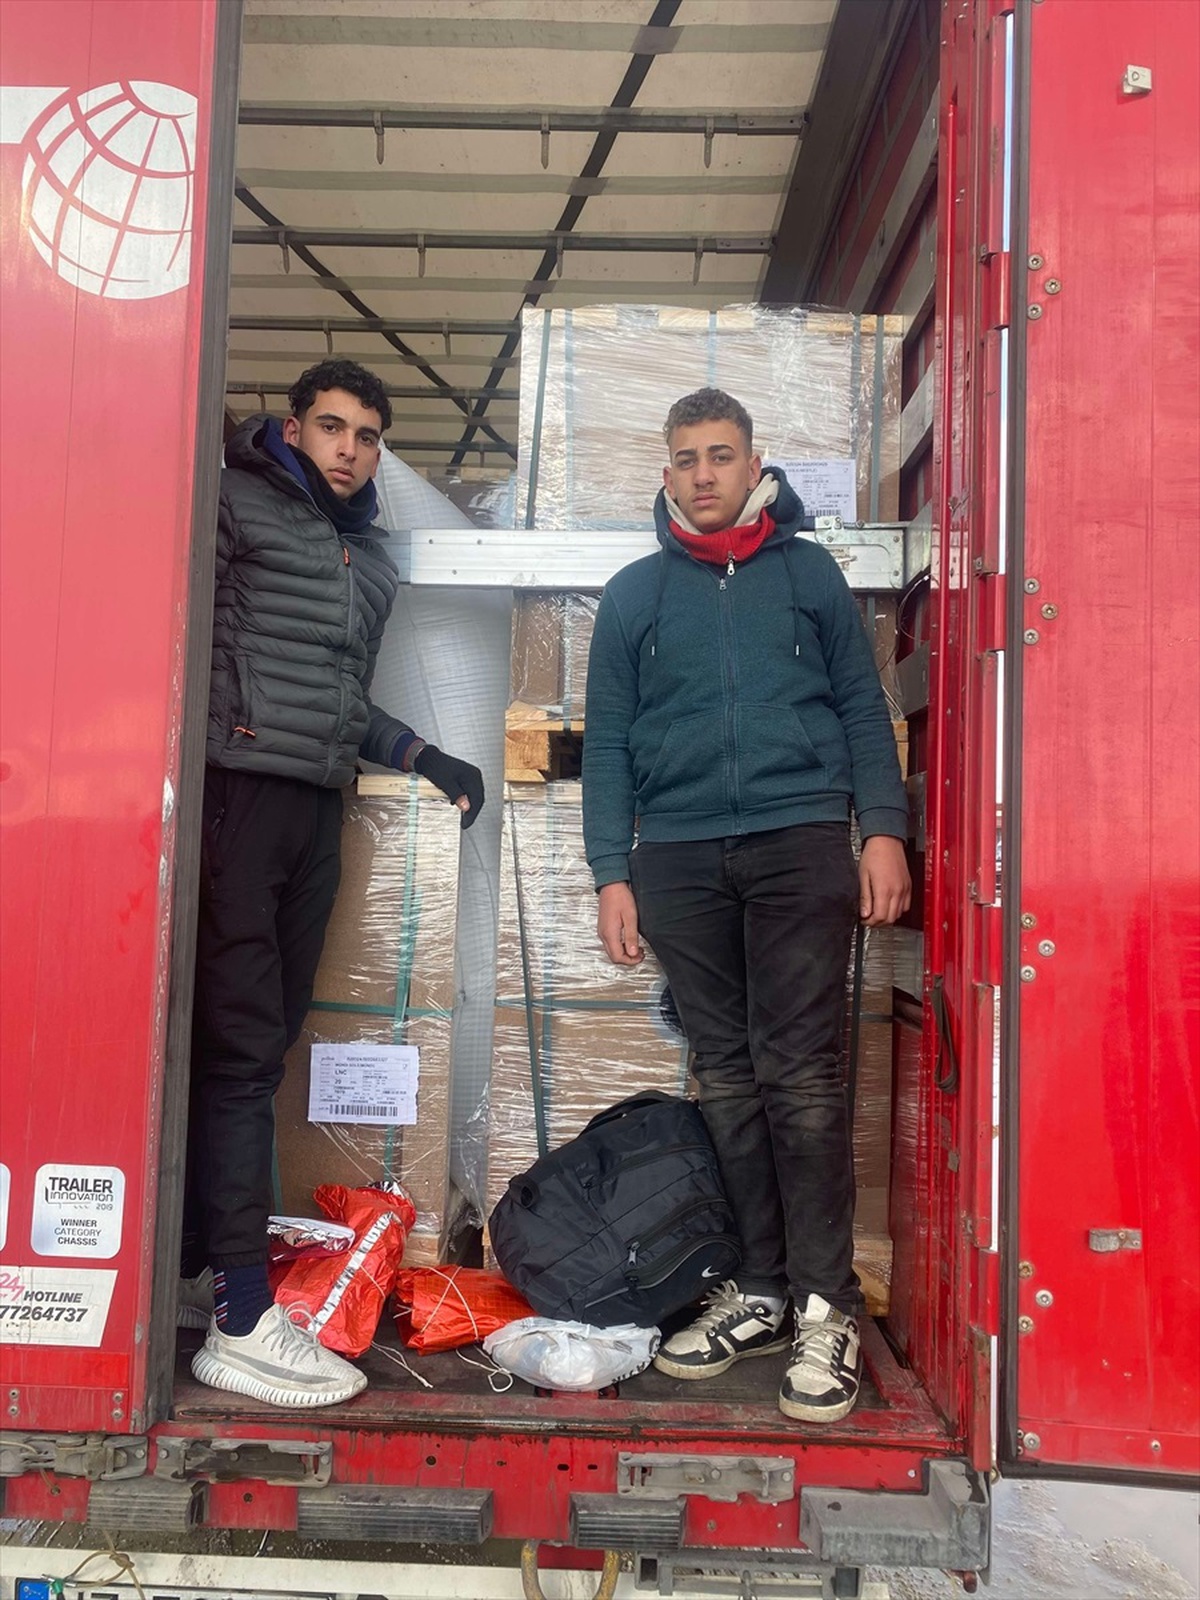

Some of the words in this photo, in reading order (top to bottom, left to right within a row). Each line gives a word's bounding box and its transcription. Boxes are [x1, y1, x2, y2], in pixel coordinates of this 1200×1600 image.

[48, 1176, 113, 1194] TRAILER
[96, 1203, 113, 1212] 2019
[60, 1218, 98, 1228] WINNER
[54, 1227, 102, 1237] CATEGORY
[57, 1236, 98, 1247] CHASSIS
[23, 1290, 83, 1303] HOTLINE
